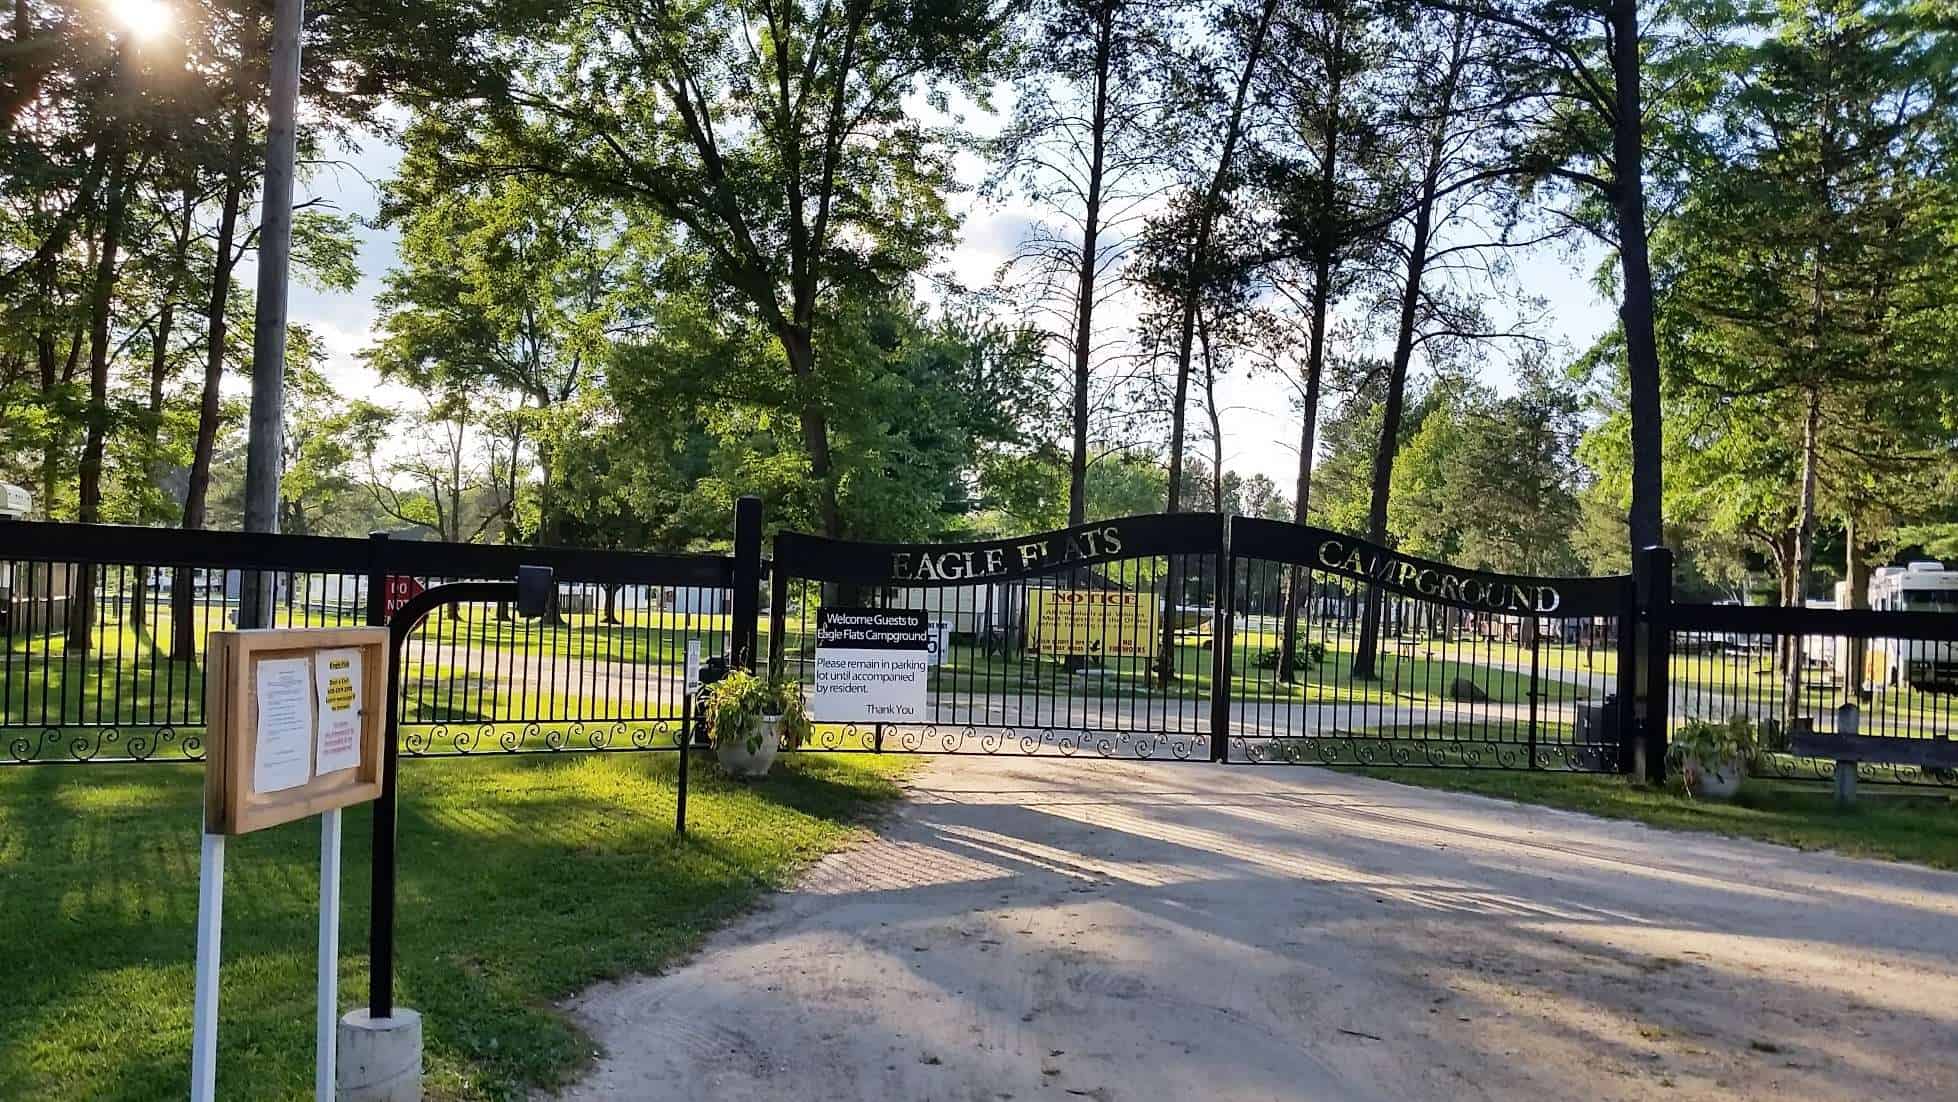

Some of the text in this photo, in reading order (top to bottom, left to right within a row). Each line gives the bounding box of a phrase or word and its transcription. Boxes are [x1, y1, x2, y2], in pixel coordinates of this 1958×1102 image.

[891, 549, 1007, 581] EAGLE
[1318, 540, 1560, 612] CAMPGROUND
[1052, 592, 1137, 605] NOTICE
[827, 613, 873, 625] Welcome
[874, 614, 906, 626] Guests
[908, 616, 919, 626] to
[817, 629, 927, 643] Eagle Flats Campground
[817, 658, 926, 673] Please remain in parking
[817, 671, 914, 683] lot until accompanied
[816, 683, 829, 695] by
[866, 704, 914, 714] Thank You
